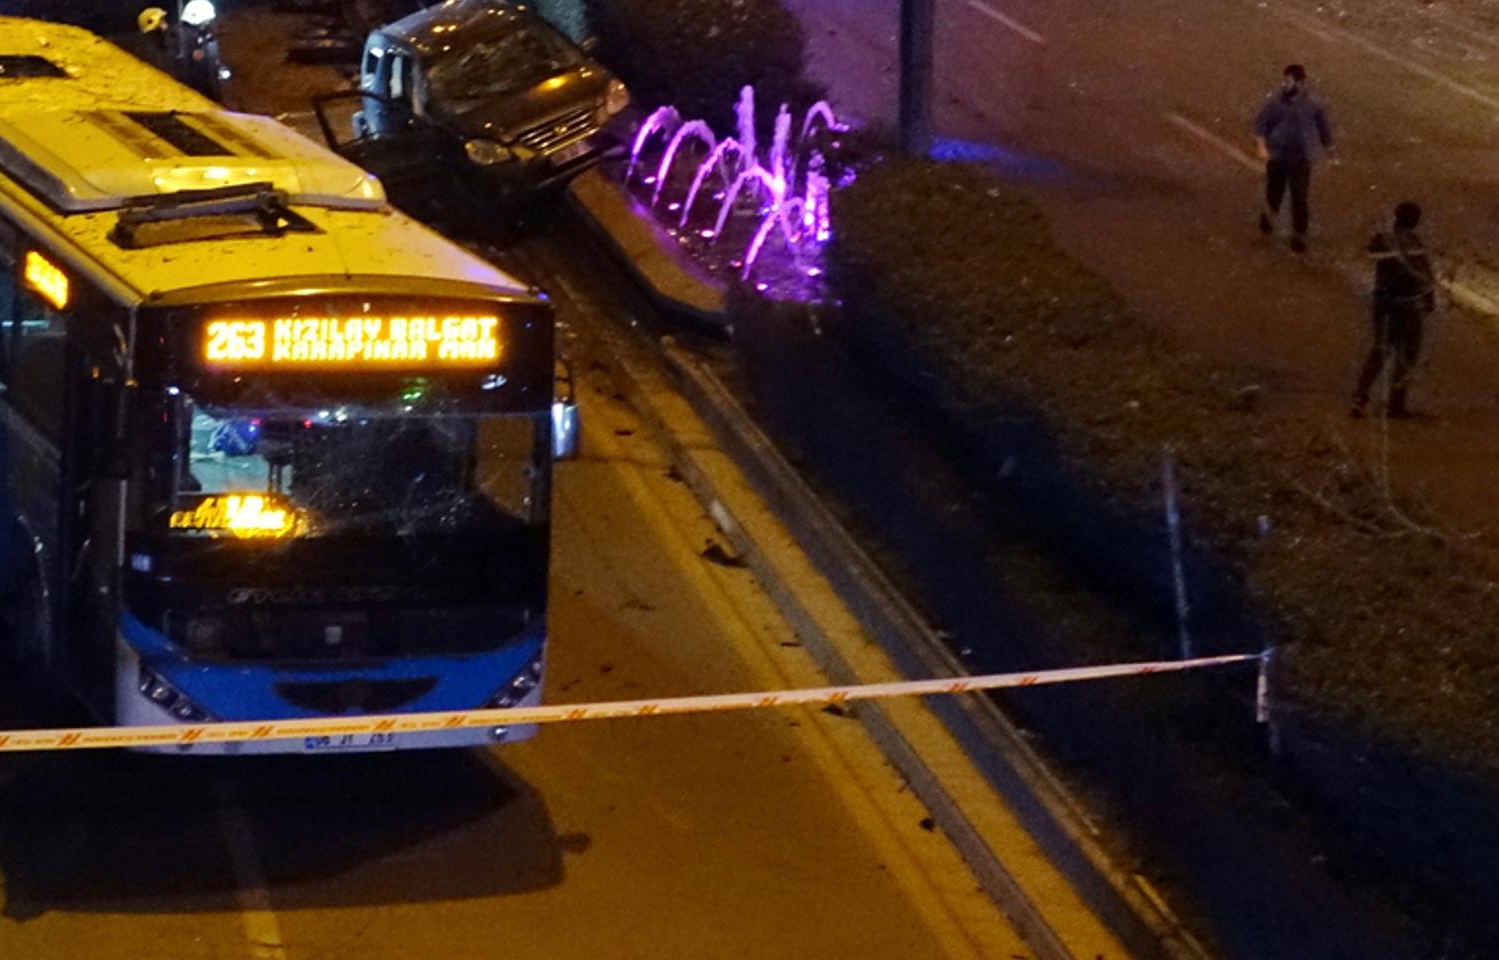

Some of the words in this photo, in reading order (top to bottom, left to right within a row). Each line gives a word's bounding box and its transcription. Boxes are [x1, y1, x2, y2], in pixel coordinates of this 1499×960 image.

[206, 320, 266, 360] 263
[389, 316, 498, 340] BALGAT
[272, 339, 428, 362] KARAPINAR
